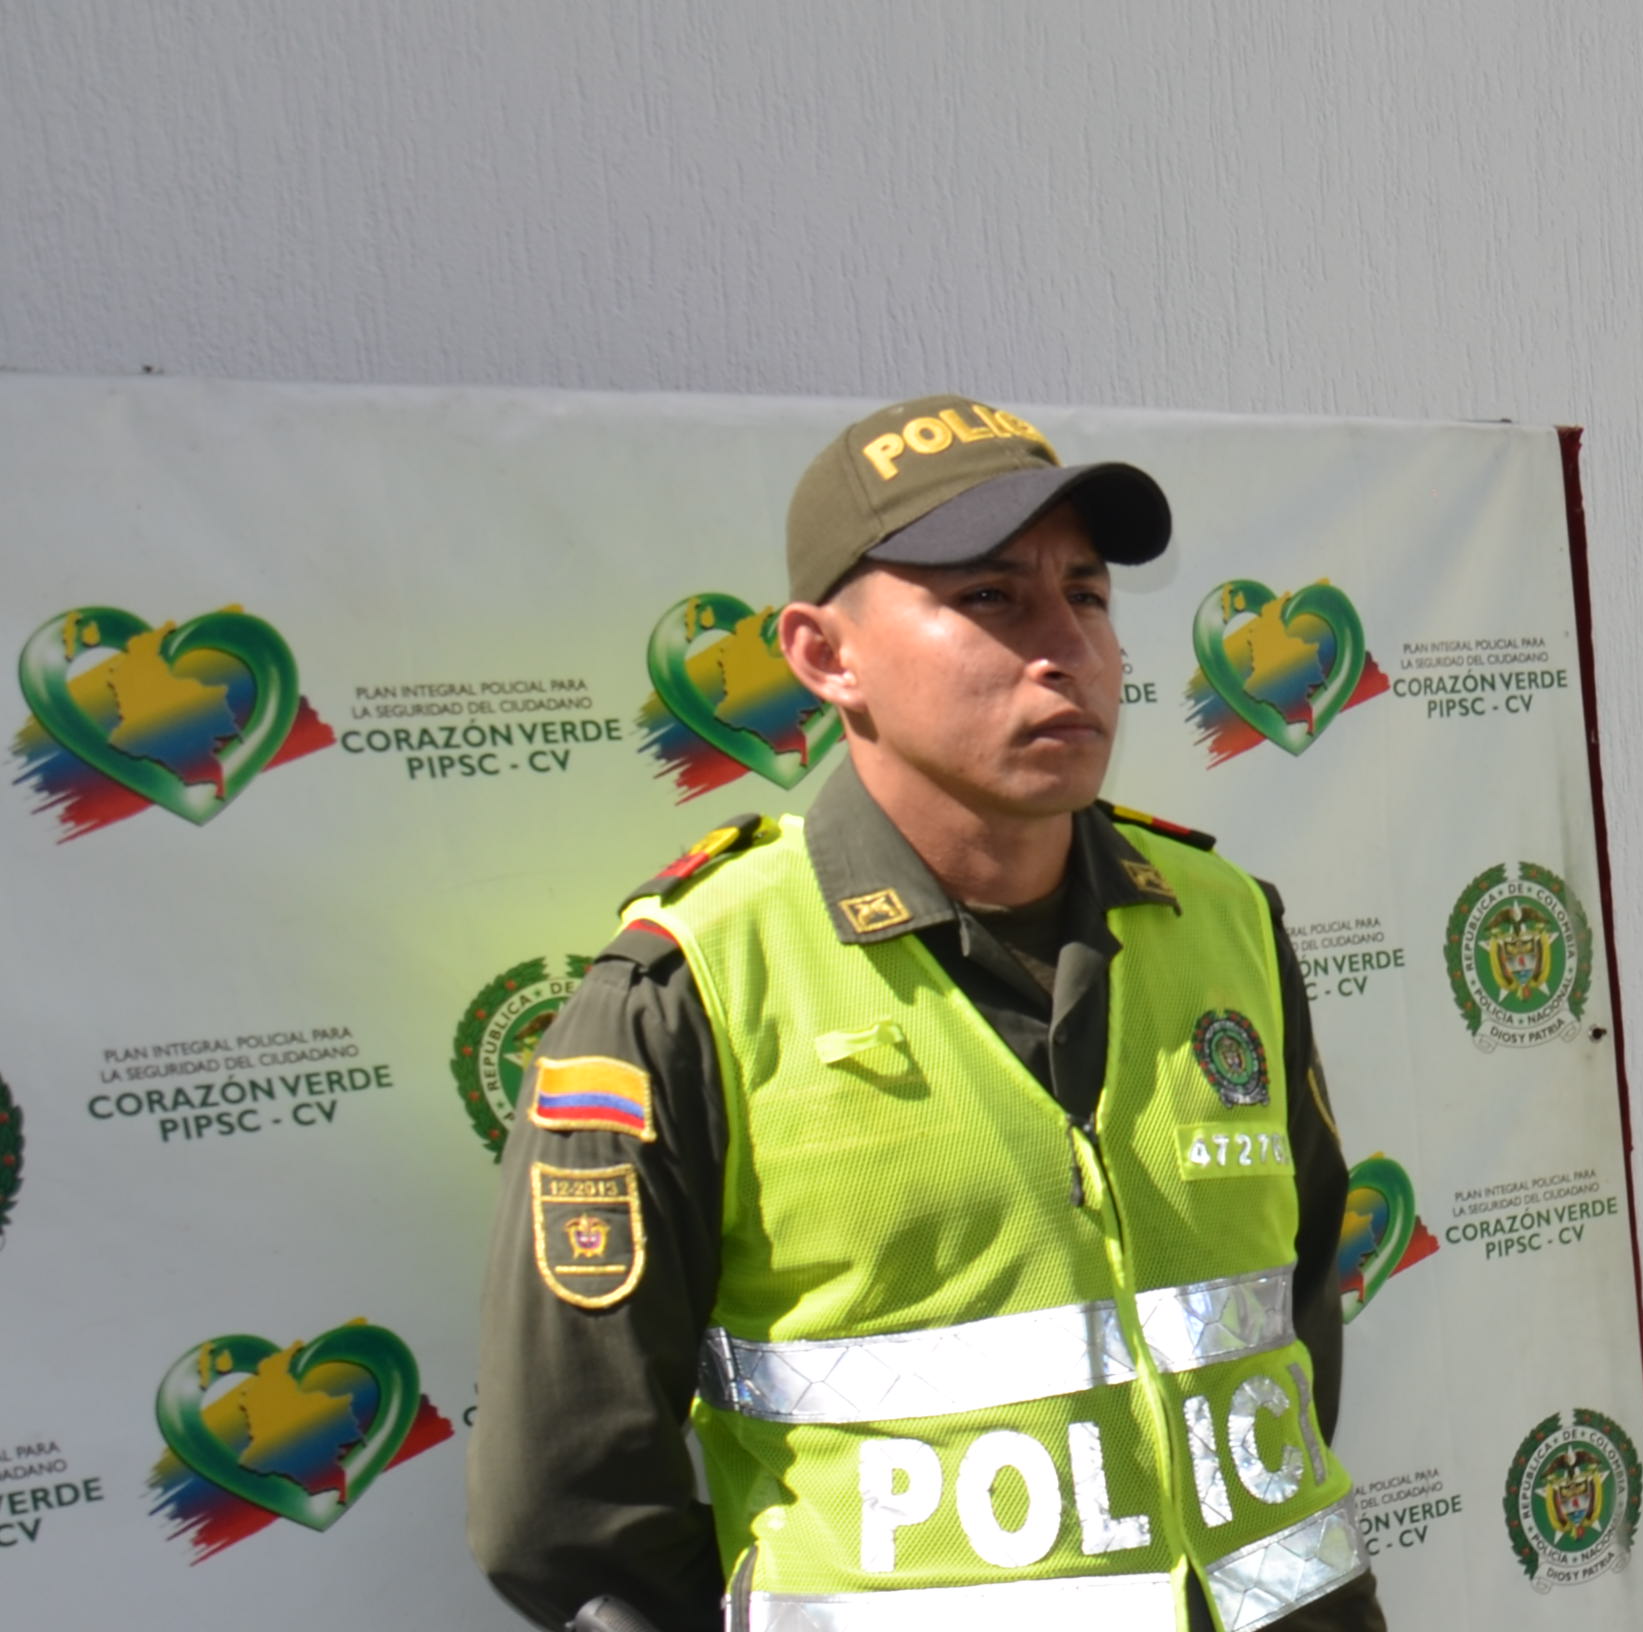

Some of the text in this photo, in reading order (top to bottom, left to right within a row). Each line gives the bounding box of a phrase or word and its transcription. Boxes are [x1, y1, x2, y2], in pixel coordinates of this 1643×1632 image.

[863, 404, 1053, 481] POLIC
[1401, 651, 1548, 669] LA SEGURIDAD DEL CIUDADANO
[1405, 637, 1544, 655] PLAN INTEGRAL POLICIAL PARA
[355, 679, 587, 699] PLAN INTEGRAL POLICIAL PARA
[1391, 669, 1568, 696] CORAZÓN VERDE
[352, 697, 593, 719] LA SEGURIDAD DEL CIUDADANO
[1427, 695, 1532, 718] PIPSC CV
[341, 718, 622, 753] CORAZÓN VERDE
[407, 750, 570, 779] PIPSC CV
[1508, 883, 1523, 894] DE
[1536, 888, 1575, 958] COLOMBIA
[1332, 949, 1404, 973] VERDE
[1338, 976, 1367, 997] CV
[1527, 978, 1572, 1025] NACIONAL
[104, 1026, 352, 1063] PLAN INTEGRAL POLICIAL PARA
[1528, 1018, 1565, 1042] PATRIA
[100, 1044, 360, 1083] LA SEGURIDAD DEL CIUDADANO
[88, 1065, 393, 1120] CORAZÓN VERDE
[160, 1100, 338, 1142] PIPSC CV
[1454, 1182, 1599, 1217] LA SEGURIDAD DEL CIUDADANO
[1457, 1168, 1596, 1202] PLAN INTEGRAL POLICIAL PARA
[1447, 1197, 1618, 1245] CORAZÓN VERDE
[1486, 1224, 1584, 1260] PIPSC CV
[1393, 1494, 1462, 1527] VERDE
[1400, 1525, 1427, 1548] CV
